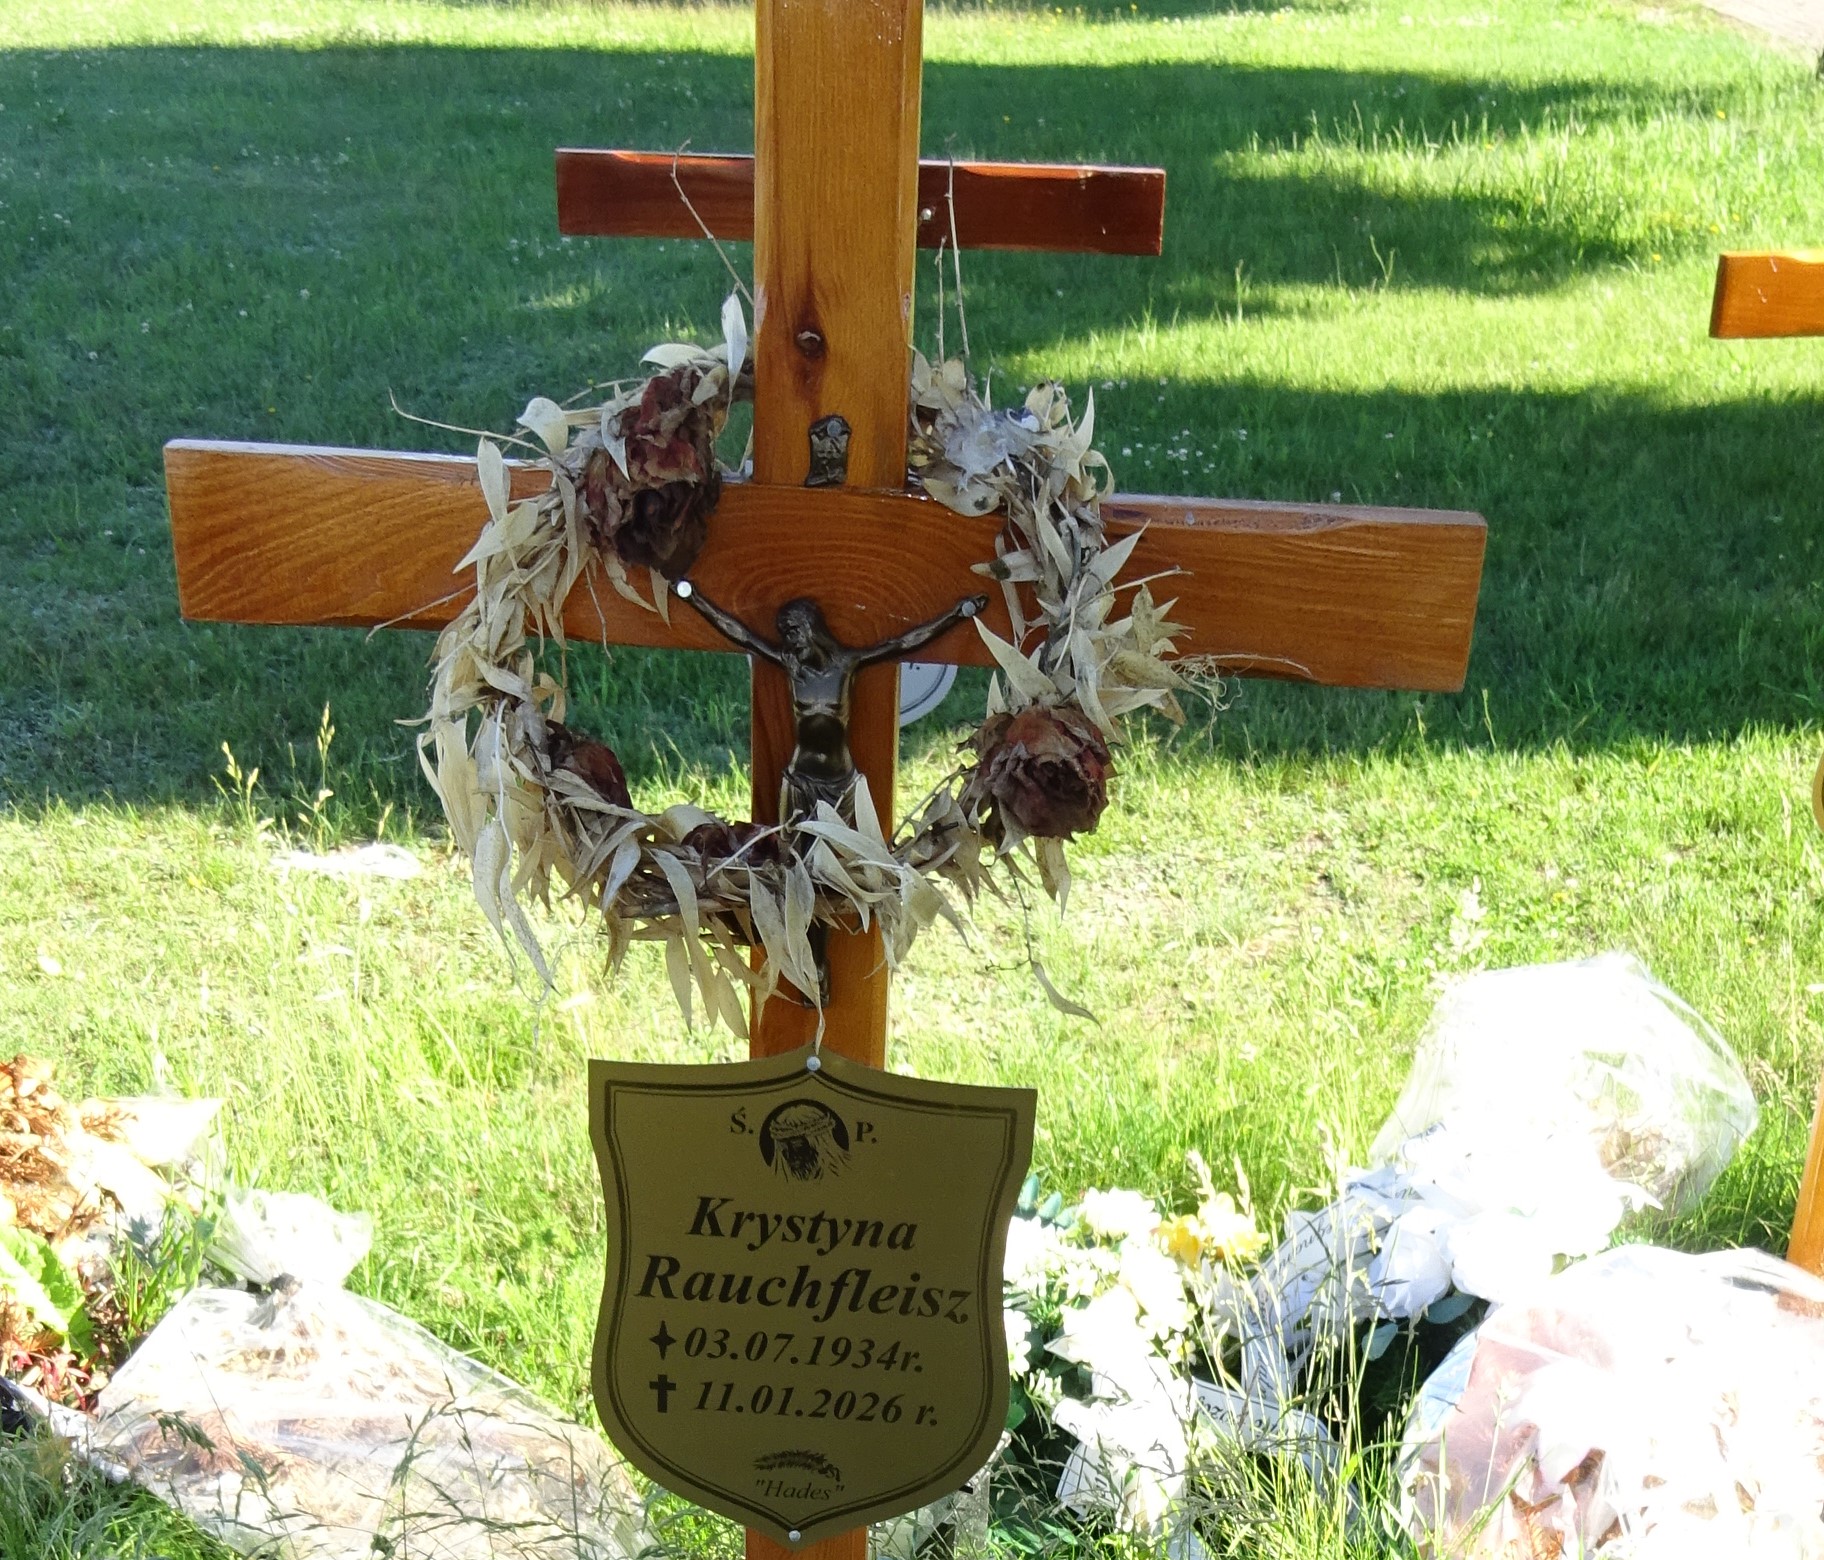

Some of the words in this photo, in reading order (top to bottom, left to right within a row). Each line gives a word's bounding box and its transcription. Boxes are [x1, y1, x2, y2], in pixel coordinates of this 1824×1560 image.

[730, 1106, 754, 1135] Ś.
[855, 1121, 878, 1144] P.
[686, 1195, 918, 1256] Krystyna
[634, 1254, 972, 1324] Rauchfleisz
[684, 1326, 923, 1373] 03.07.1934r.
[695, 1381, 905, 1424] 11.01.2026
[915, 1404, 938, 1426] r.
[756, 1479, 845, 1500] "Hades"
